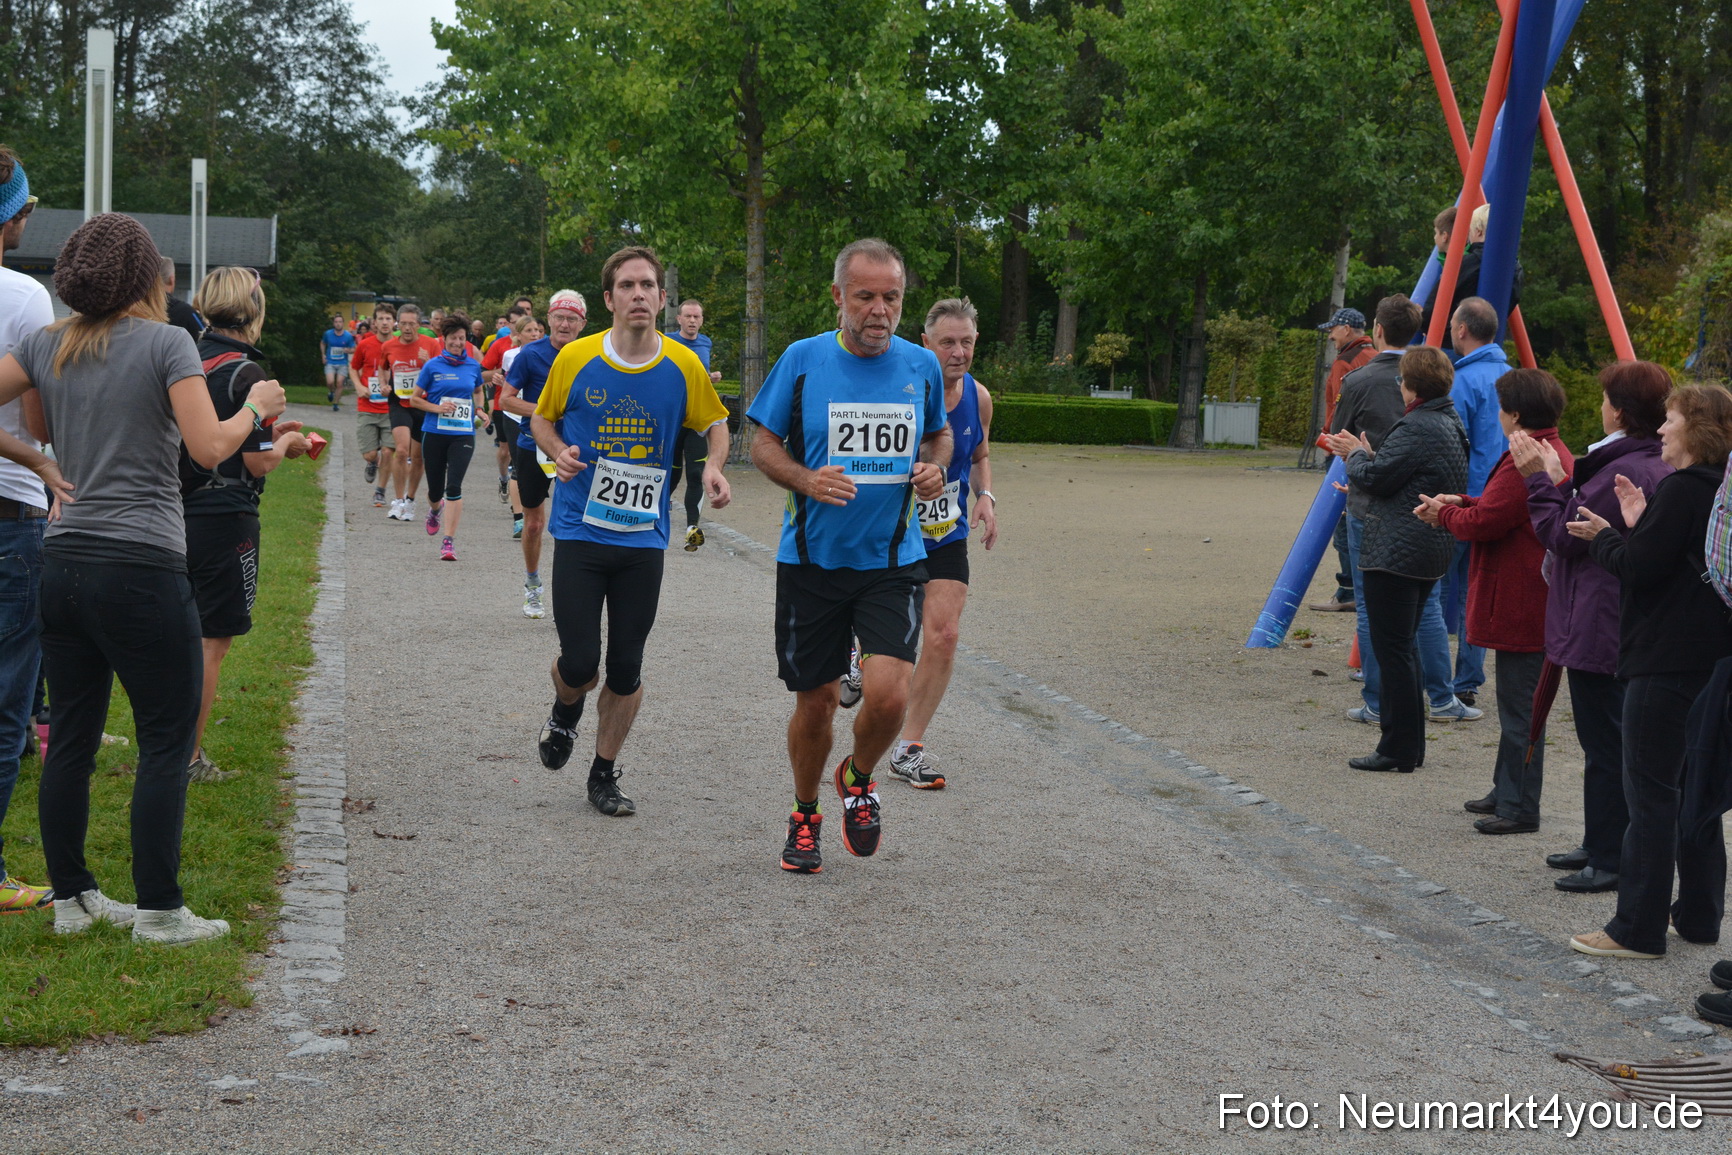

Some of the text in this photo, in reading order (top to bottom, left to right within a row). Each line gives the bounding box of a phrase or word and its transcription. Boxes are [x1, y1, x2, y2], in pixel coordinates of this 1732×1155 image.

[402, 378, 415, 389] 57
[830, 410, 902, 420] PARTL Neumarkt
[838, 423, 909, 453] 2160
[597, 463, 621, 477] PARTL
[622, 470, 652, 481] Neumarkt
[851, 460, 894, 473] Herbert
[597, 476, 655, 510] 2916
[605, 509, 640, 525] Florian
[917, 497, 950, 523] 249
